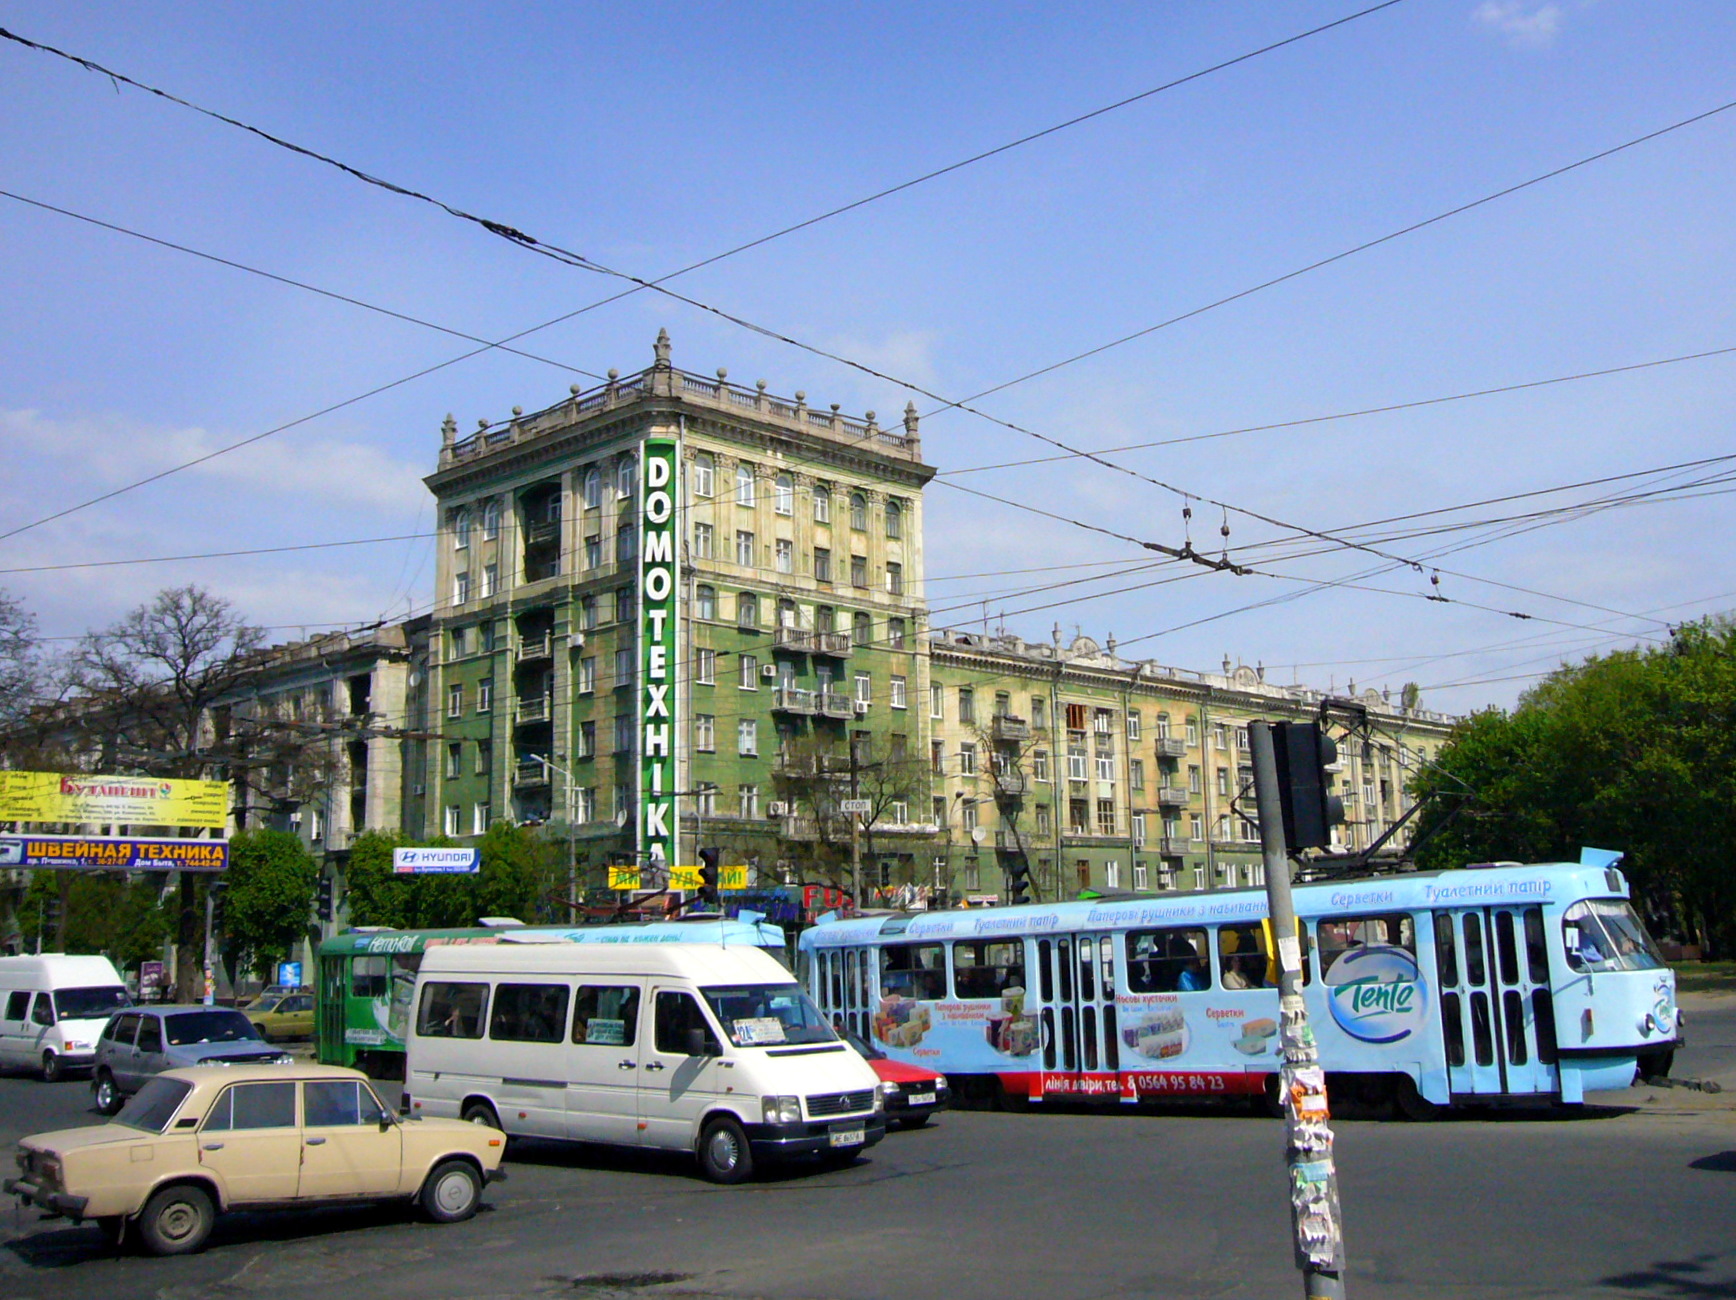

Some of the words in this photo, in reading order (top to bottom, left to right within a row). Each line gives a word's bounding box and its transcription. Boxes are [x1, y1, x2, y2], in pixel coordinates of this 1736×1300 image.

[27, 840, 132, 858] ШВЕЙНАЯ
[136, 843, 224, 860] ТЕХНИКА
[422, 853, 472, 862] HYUNDAI
[134, 858, 151, 867] Дом
[1331, 890, 1393, 908] Серветки
[1424, 883, 1504, 901] Туалетний
[1508, 879, 1552, 897] папір
[1087, 908, 1138, 925] Паперові
[1141, 905, 1195, 924] рушники
[1210, 901, 1268, 916] набиванн
[909, 922, 953, 937] Серветки
[974, 917, 1027, 934] Туалетний
[1029, 913, 1060, 928] папір
[1116, 994, 1141, 1004] Носові
[1142, 993, 1178, 1007] хусточки
[1334, 973, 1415, 1013] Tento
[1206, 1008, 1245, 1021] Серветки
[1045, 1075, 1070, 1093] лінія
[1127, 1075, 1134, 1090] 8
[1139, 1074, 1168, 1091] 0564
[1171, 1074, 1187, 1091] 95
[1189, 1074, 1206, 1091] 84
[1208, 1075, 1225, 1091] 23
